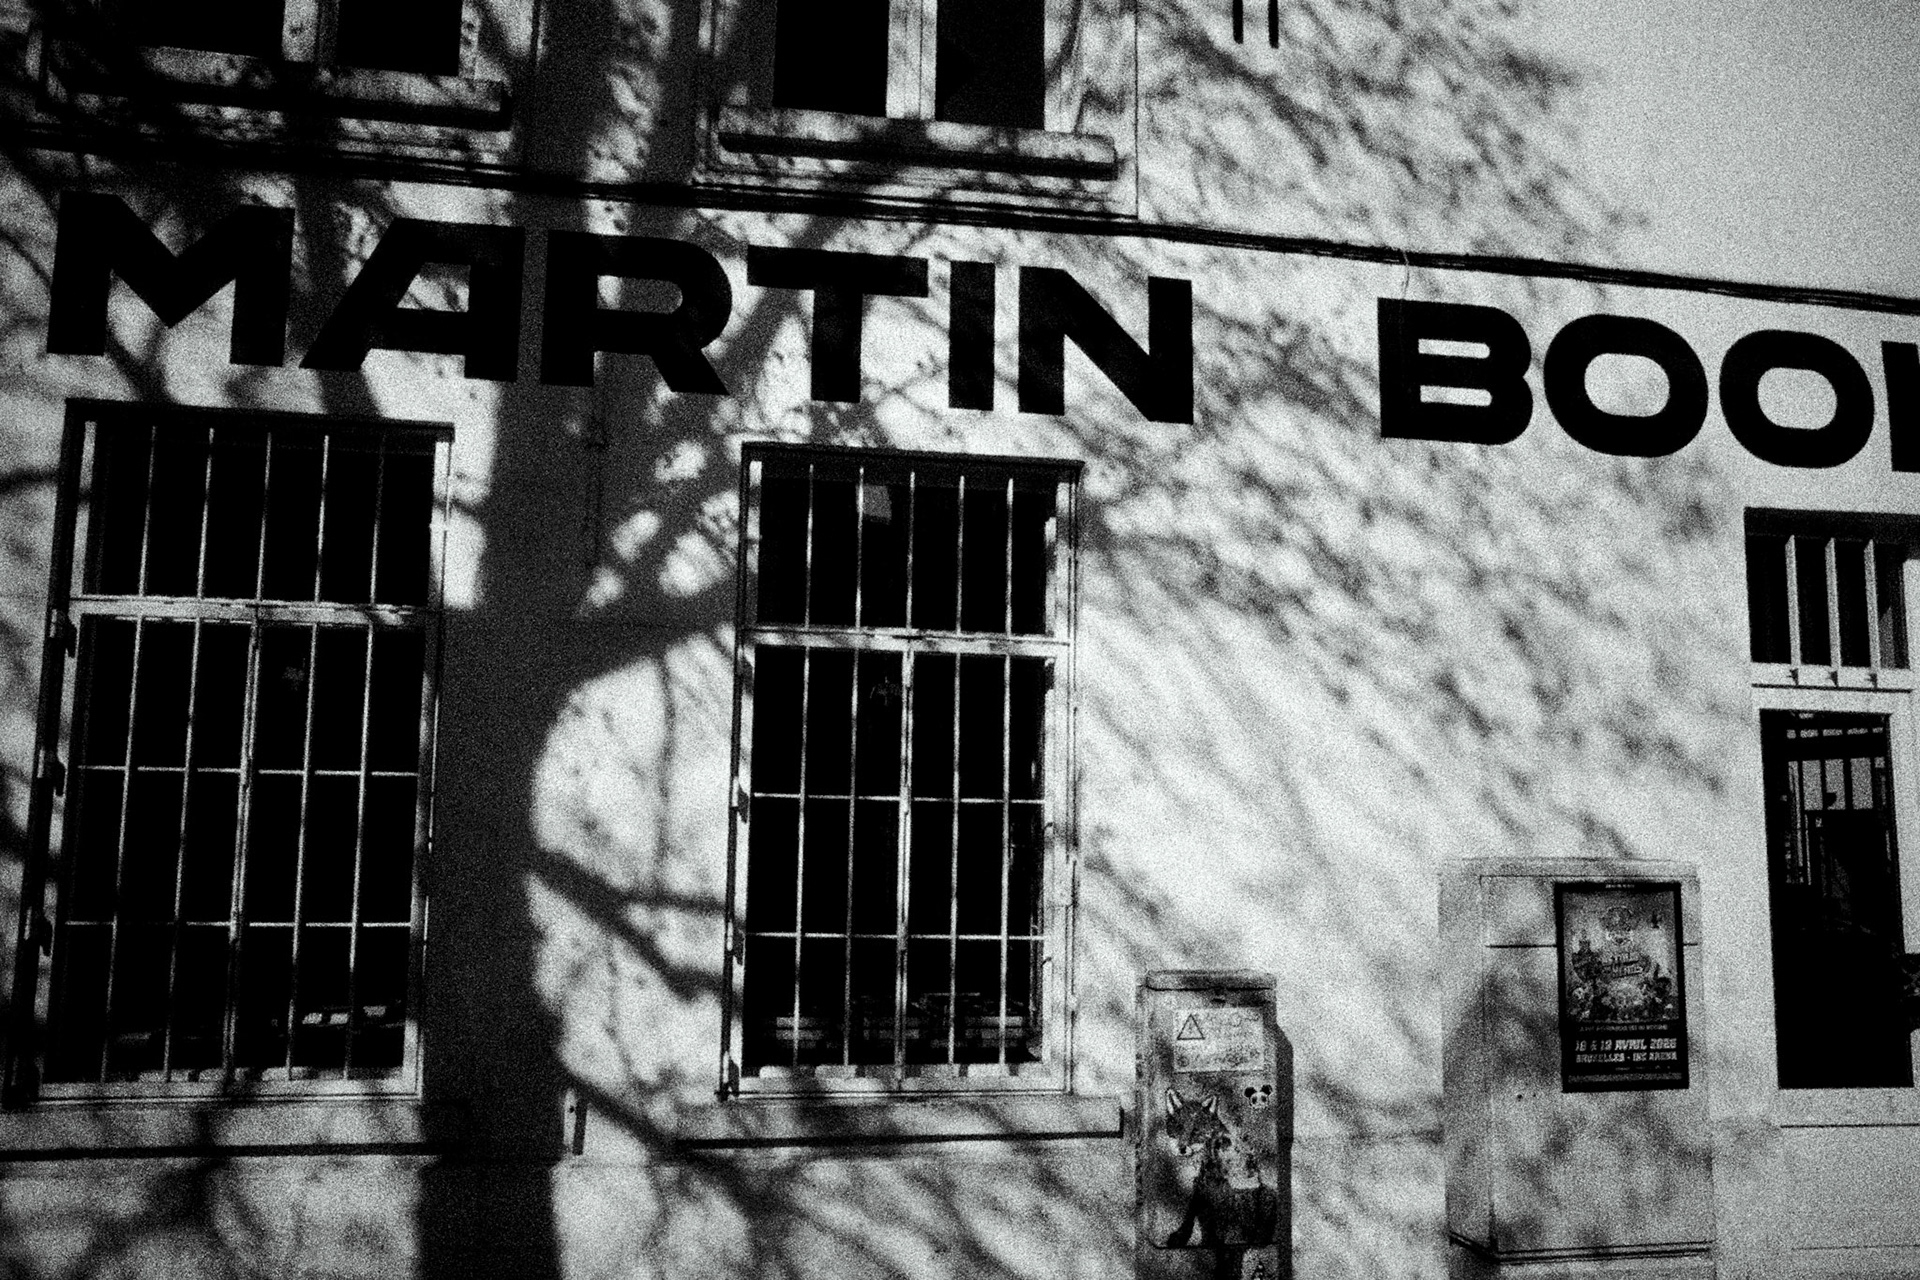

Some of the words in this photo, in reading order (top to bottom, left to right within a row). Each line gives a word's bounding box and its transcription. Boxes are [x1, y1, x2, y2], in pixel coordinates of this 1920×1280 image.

[47, 190, 1194, 424] MARTIN
[1614, 1038, 1648, 1050] AVRIL
[1575, 1053, 1625, 1063] BRUXELLES
